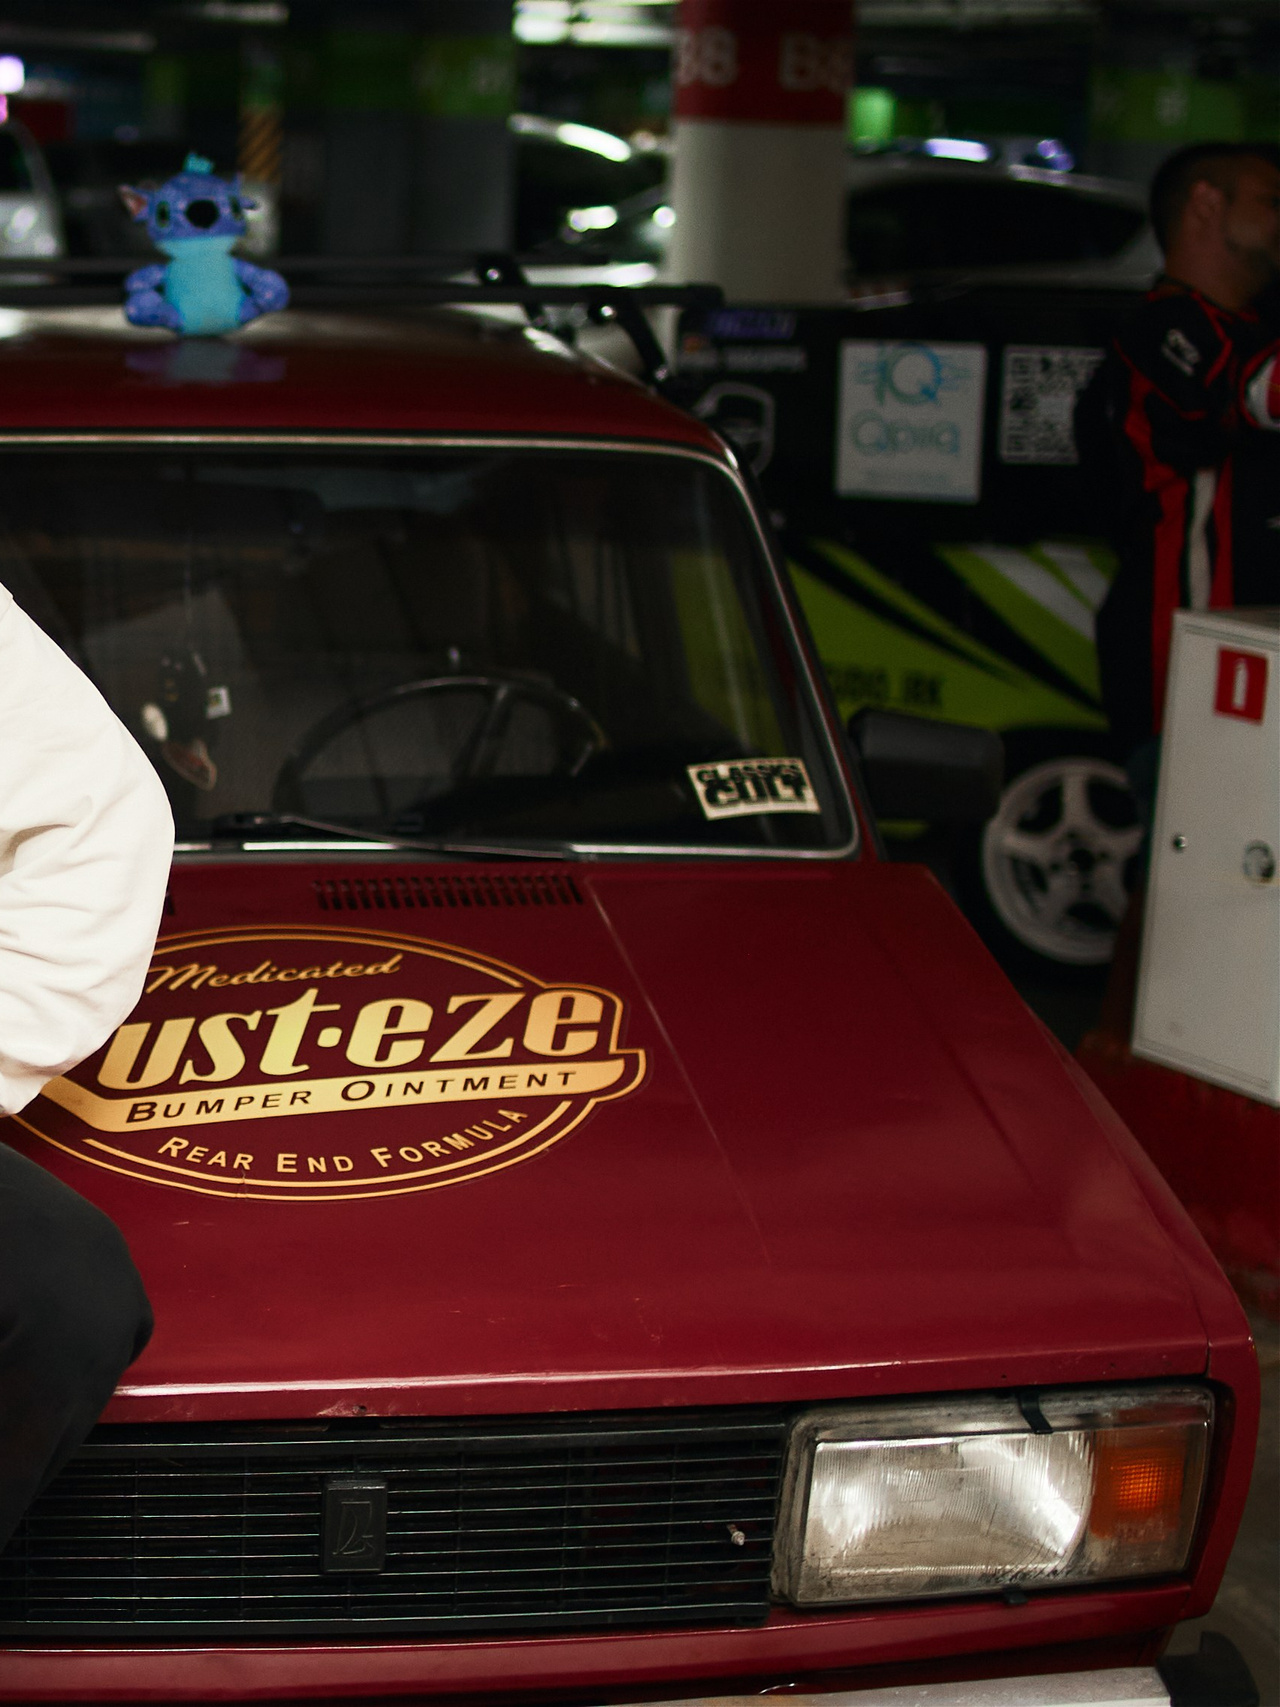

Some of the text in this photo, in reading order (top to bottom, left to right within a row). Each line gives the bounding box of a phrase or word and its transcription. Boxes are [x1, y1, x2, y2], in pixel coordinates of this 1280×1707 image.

[146, 953, 403, 994] Medicated
[125, 1071, 578, 1124] BUMPER OINTMENT
[157, 1108, 529, 1174] REAR END FORMULA
